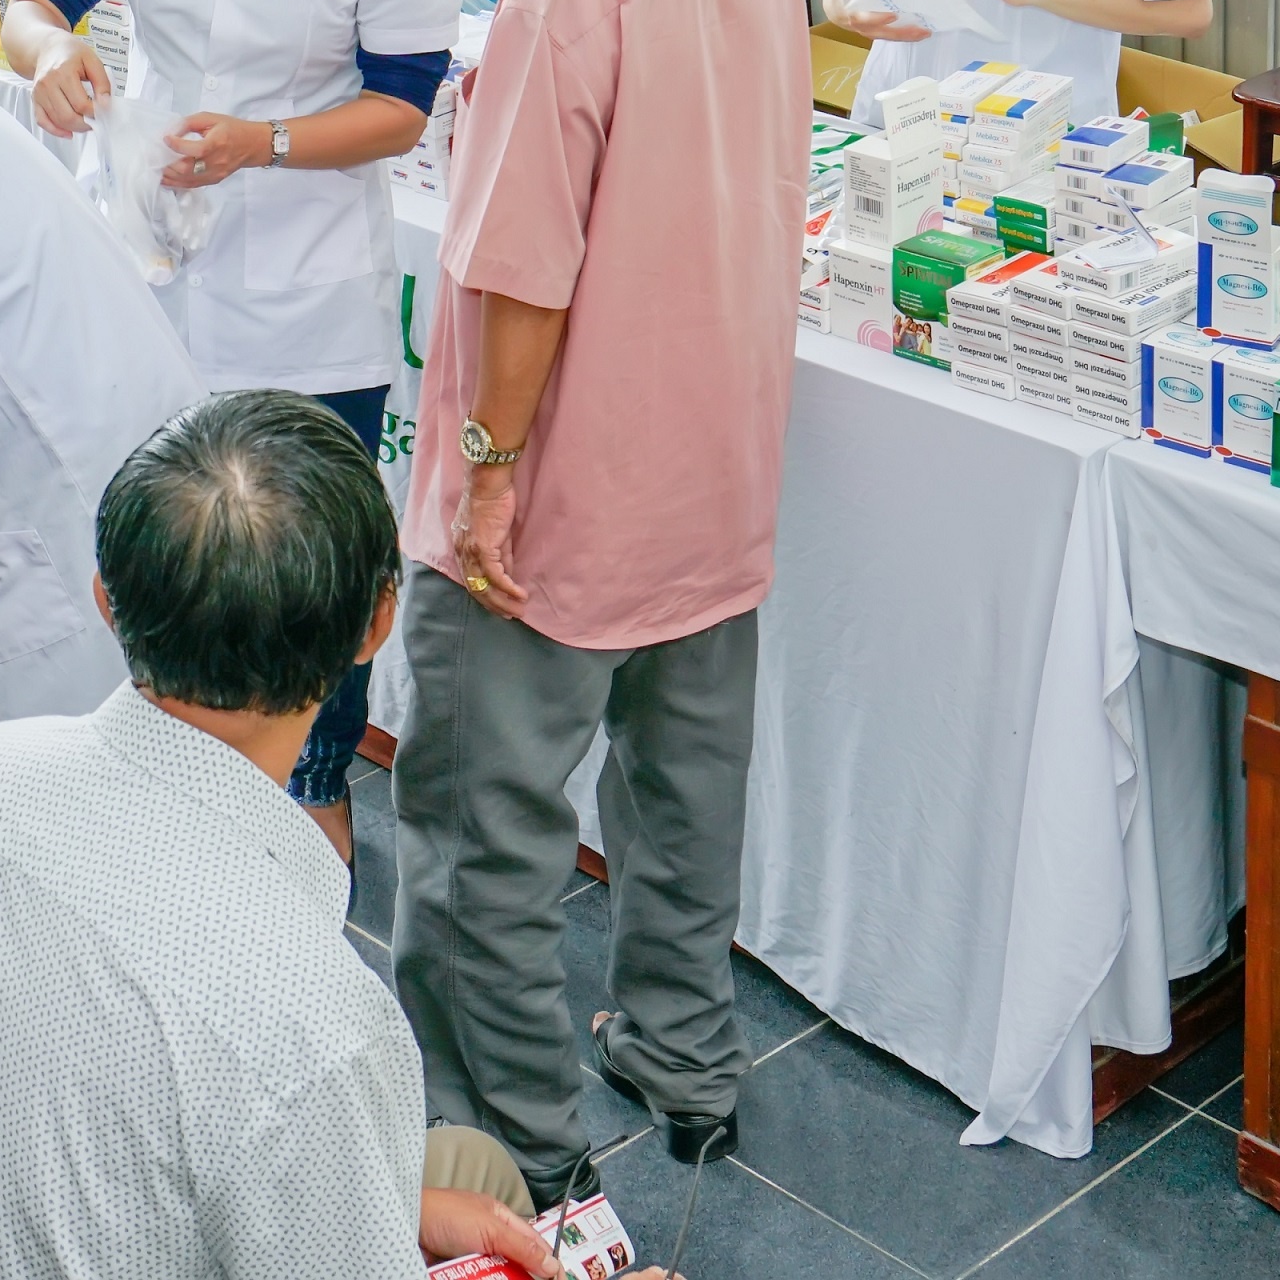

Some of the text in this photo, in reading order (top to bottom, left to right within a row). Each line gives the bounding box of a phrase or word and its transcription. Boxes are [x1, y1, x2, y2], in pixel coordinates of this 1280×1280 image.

[901, 110, 936, 128] Hapenxin
[976, 132, 1000, 142] Mebilax
[970, 155, 992, 164] Mebilax
[898, 168, 940, 193] Hapenxin HT
[963, 169, 983, 180] Mebilax
[834, 272, 885, 295] Hapenxin HT
[1076, 276, 1108, 291] Omeprazol
[1223, 278, 1262, 292] Magnesi-B6
[951, 297, 1000, 316] Omeprazol DHG
[1013, 287, 1062, 309] Omeprazol DHG
[1076, 303, 1125, 324] Omeprazol DHG
[952, 322, 1001, 341] Omeprazol DHG
[1011, 315, 1061, 336] Omeprazol DHG
[1073, 331, 1124, 352] Omeprazol DHG
[958, 345, 1007, 364] Omeprazol DHG
[1029, 349, 1063, 364] Omeprazol
[956, 370, 1005, 390] Omeprazol DHG
[1017, 362, 1067, 383] Omeprazol DHG
[1091, 365, 1126, 381] Omeprazol
[1020, 384, 1071, 405] Omeprazol DHG
[1163, 380, 1198, 396] Magnesi-B6
[1092, 390, 1127, 406] Omeprazol
[1233, 398, 1270, 414] Magnesi-B6
[1077, 406, 1130, 427] Omeprazol DHG
